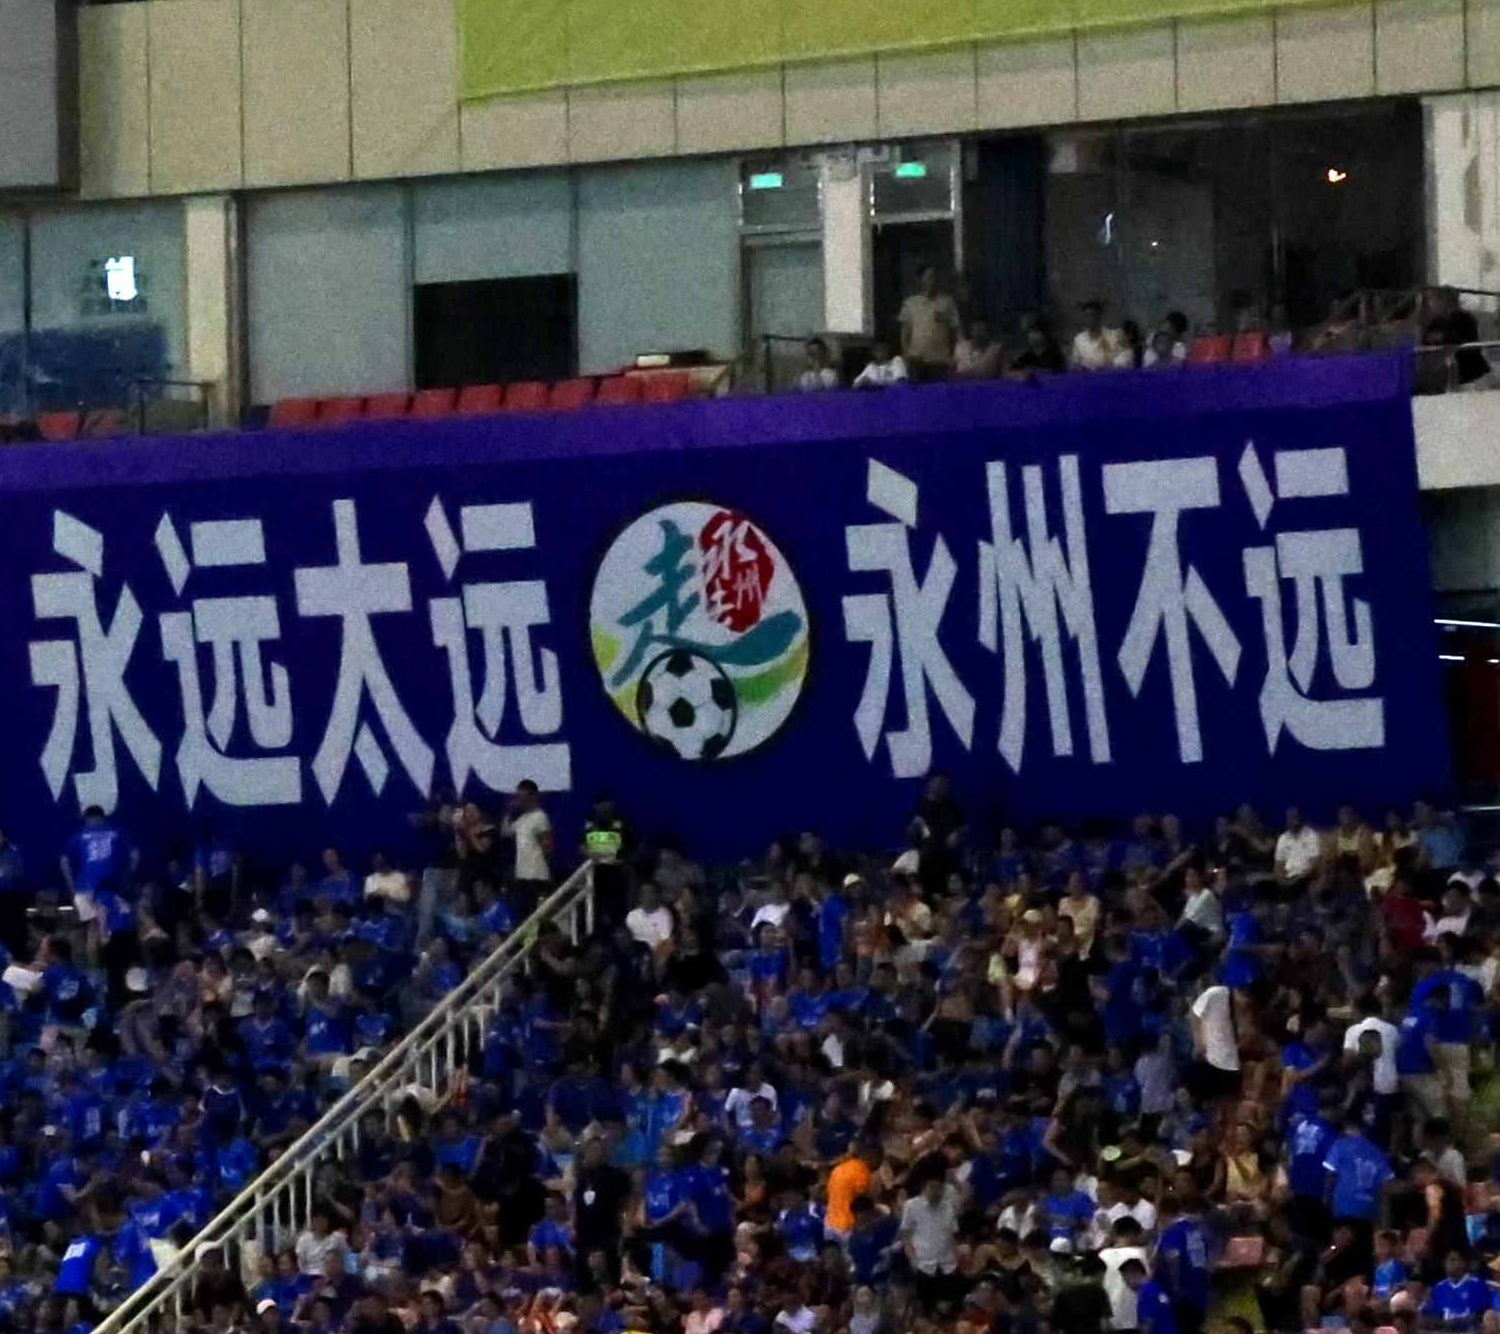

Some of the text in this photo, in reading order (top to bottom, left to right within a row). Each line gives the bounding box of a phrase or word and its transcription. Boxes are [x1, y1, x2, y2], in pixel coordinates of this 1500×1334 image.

[30, 495, 573, 815] 永远太远
[843, 439, 1387, 780] 永州不远
